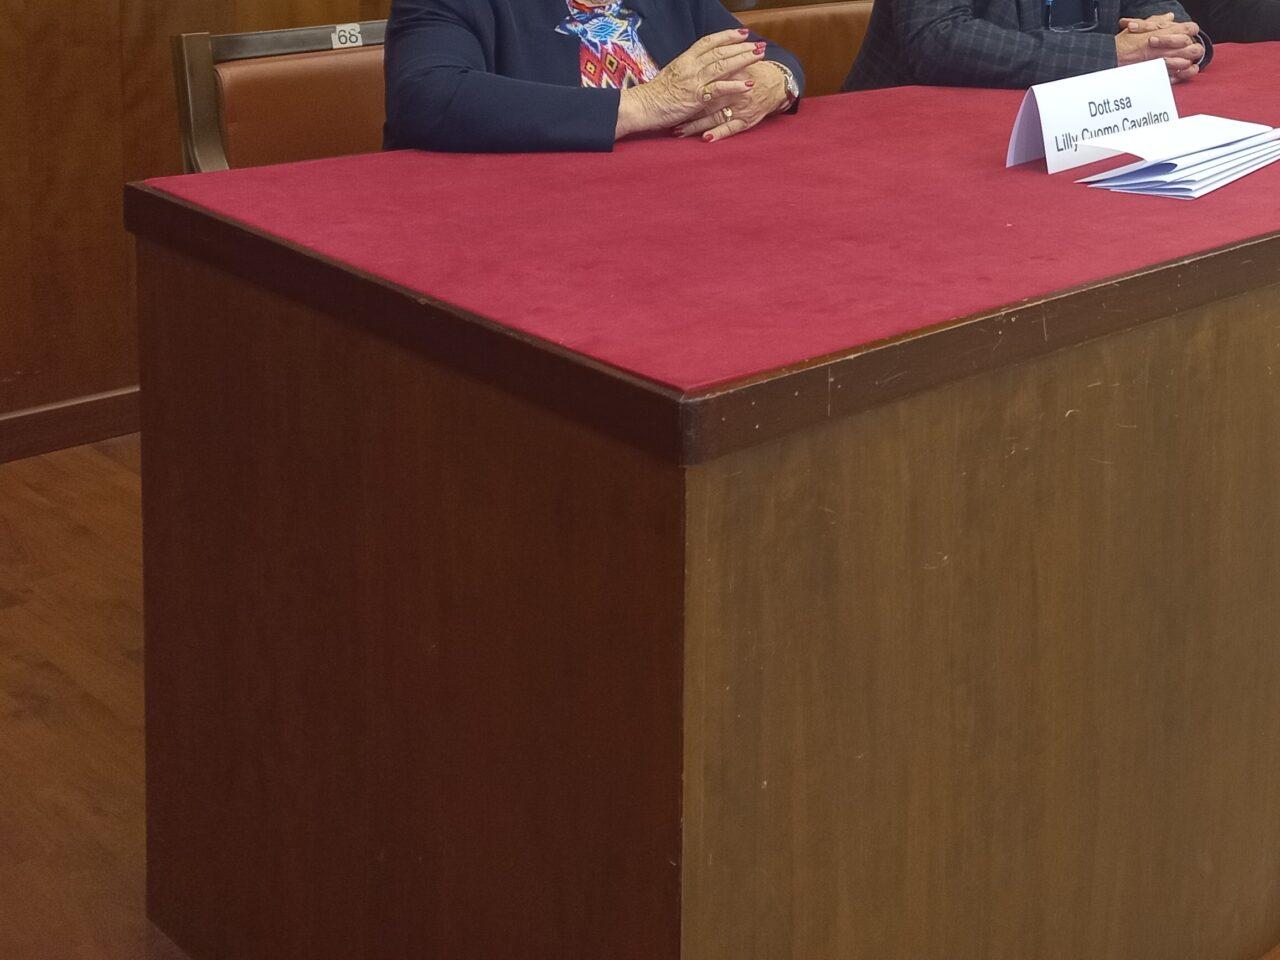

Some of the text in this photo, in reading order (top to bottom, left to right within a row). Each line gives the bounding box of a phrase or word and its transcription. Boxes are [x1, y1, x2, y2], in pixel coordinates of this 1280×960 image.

[1088, 95, 1132, 118] Dott.ssa
[1055, 131, 1078, 152] Lilly
[1121, 110, 1170, 132] Cavallaro
